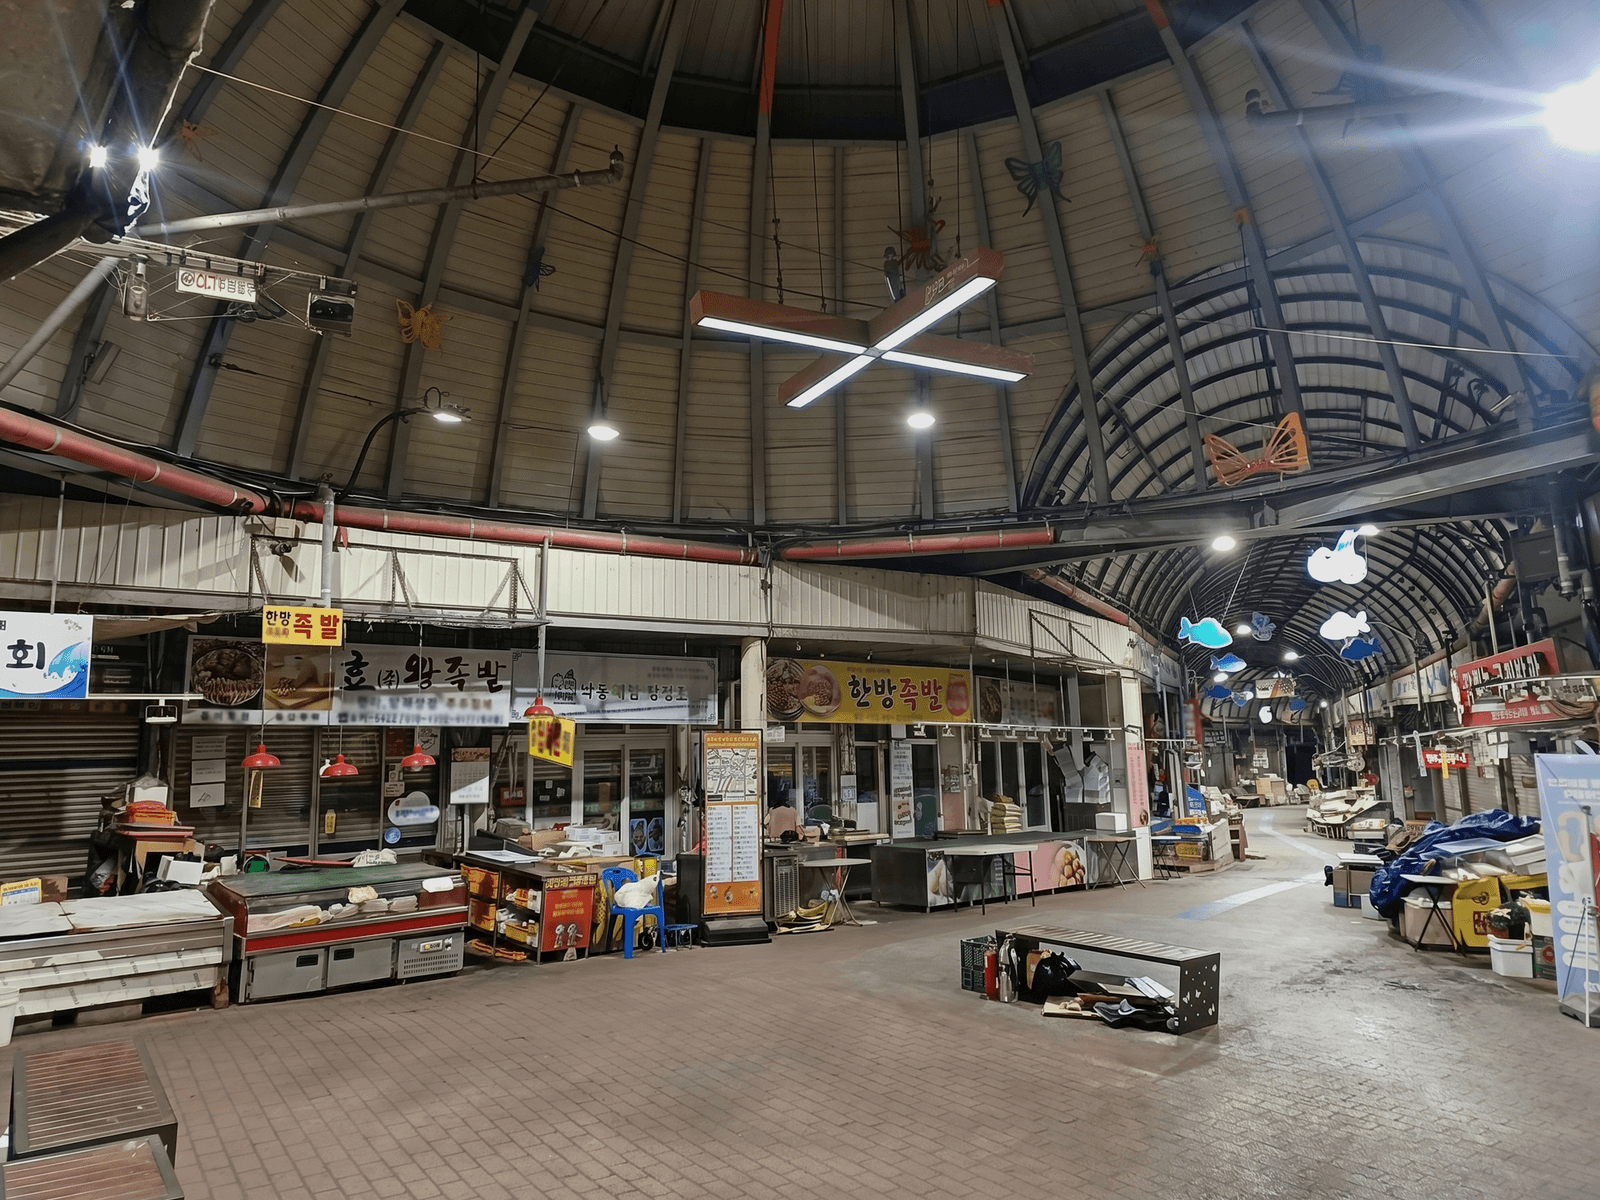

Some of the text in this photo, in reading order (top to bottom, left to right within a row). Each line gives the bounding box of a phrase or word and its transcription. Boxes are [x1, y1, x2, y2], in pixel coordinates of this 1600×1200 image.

[266, 610, 292, 627] 한방
[293, 613, 340, 640] 족발
[5, 638, 46, 670] 회
